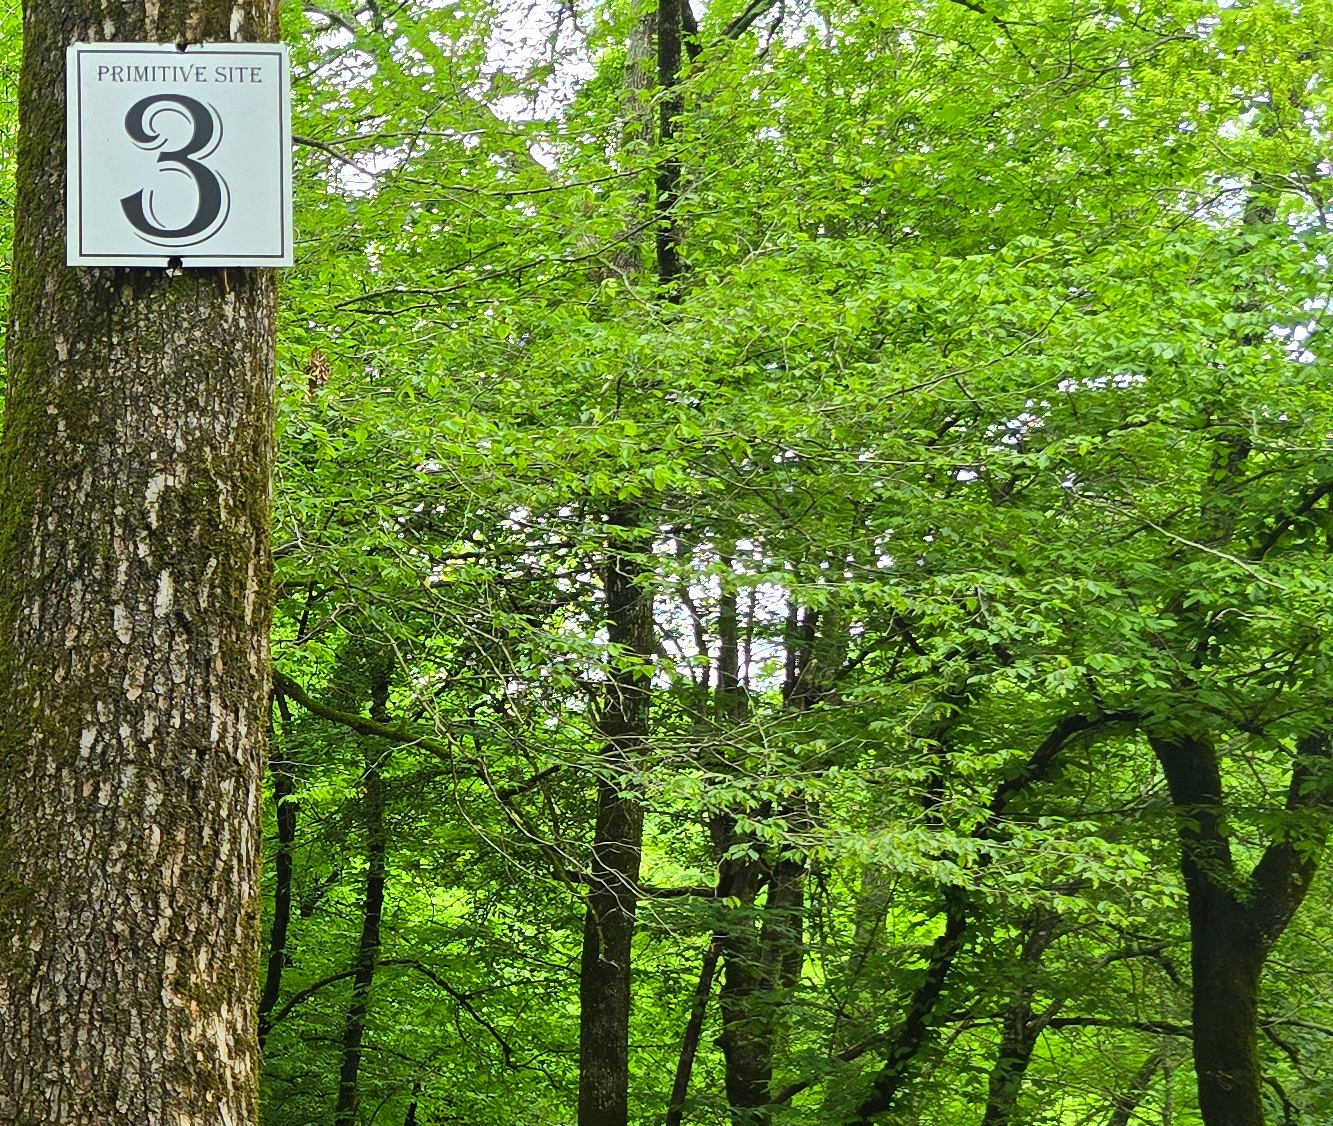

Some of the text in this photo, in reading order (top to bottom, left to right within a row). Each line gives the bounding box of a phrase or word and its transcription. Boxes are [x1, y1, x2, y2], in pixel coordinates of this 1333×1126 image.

[97, 64, 263, 83] PRIMITIVE SITE
[120, 93, 230, 248] 3
